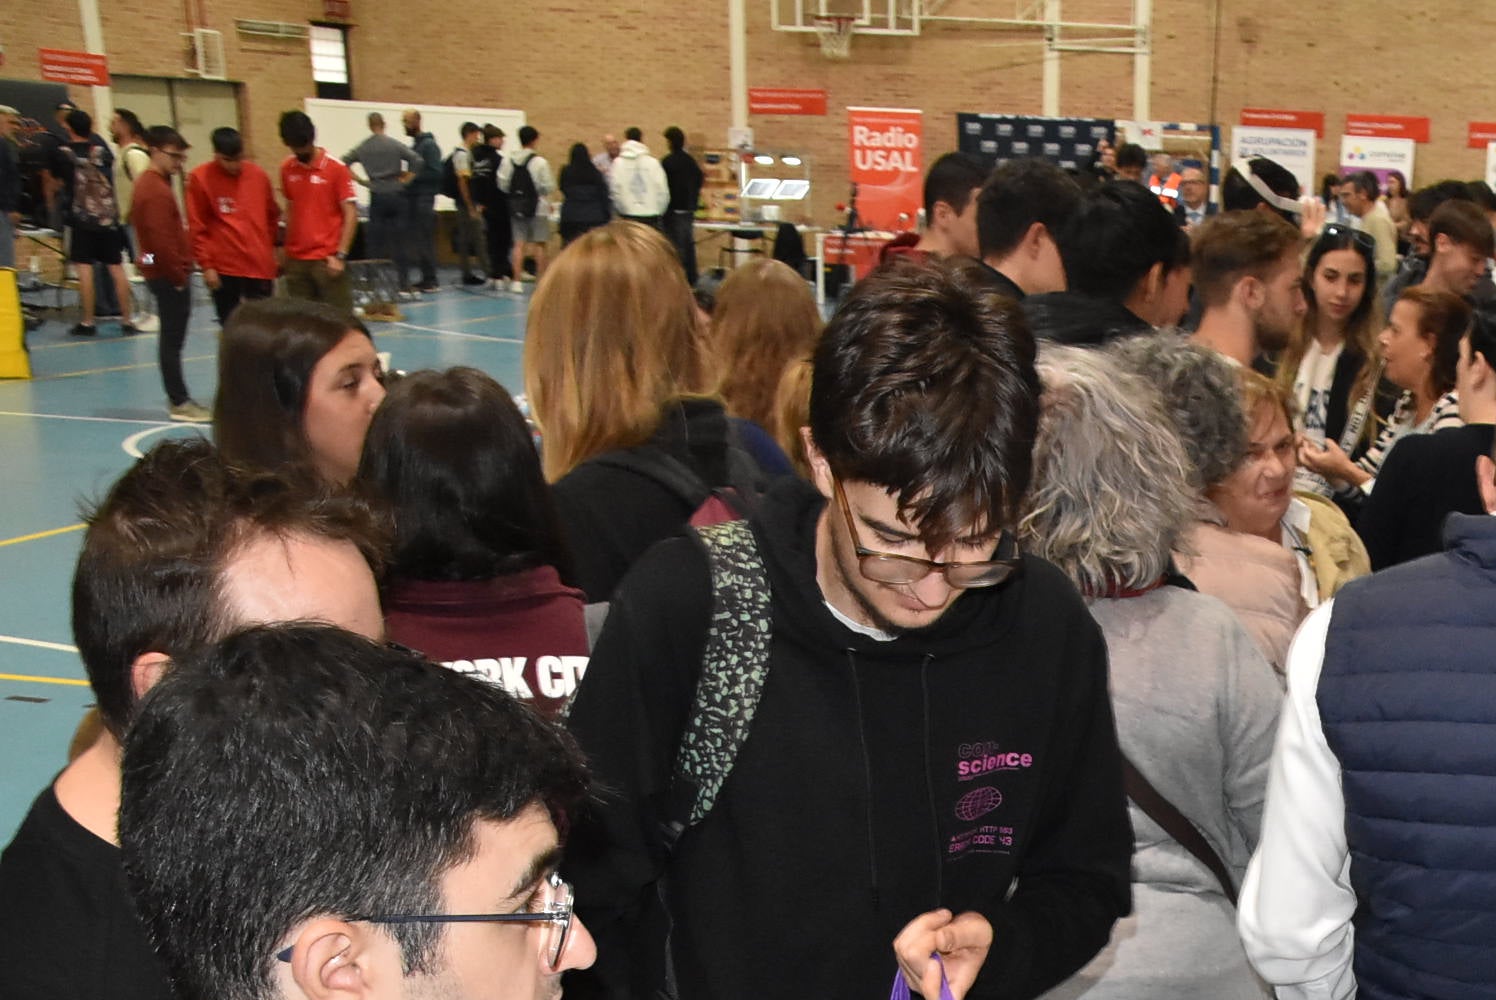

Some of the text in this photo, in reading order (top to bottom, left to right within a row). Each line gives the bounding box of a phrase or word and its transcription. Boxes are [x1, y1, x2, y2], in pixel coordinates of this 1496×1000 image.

[852, 125, 919, 148] Radio
[854, 149, 919, 172] USAL
[957, 751, 1033, 775] science
